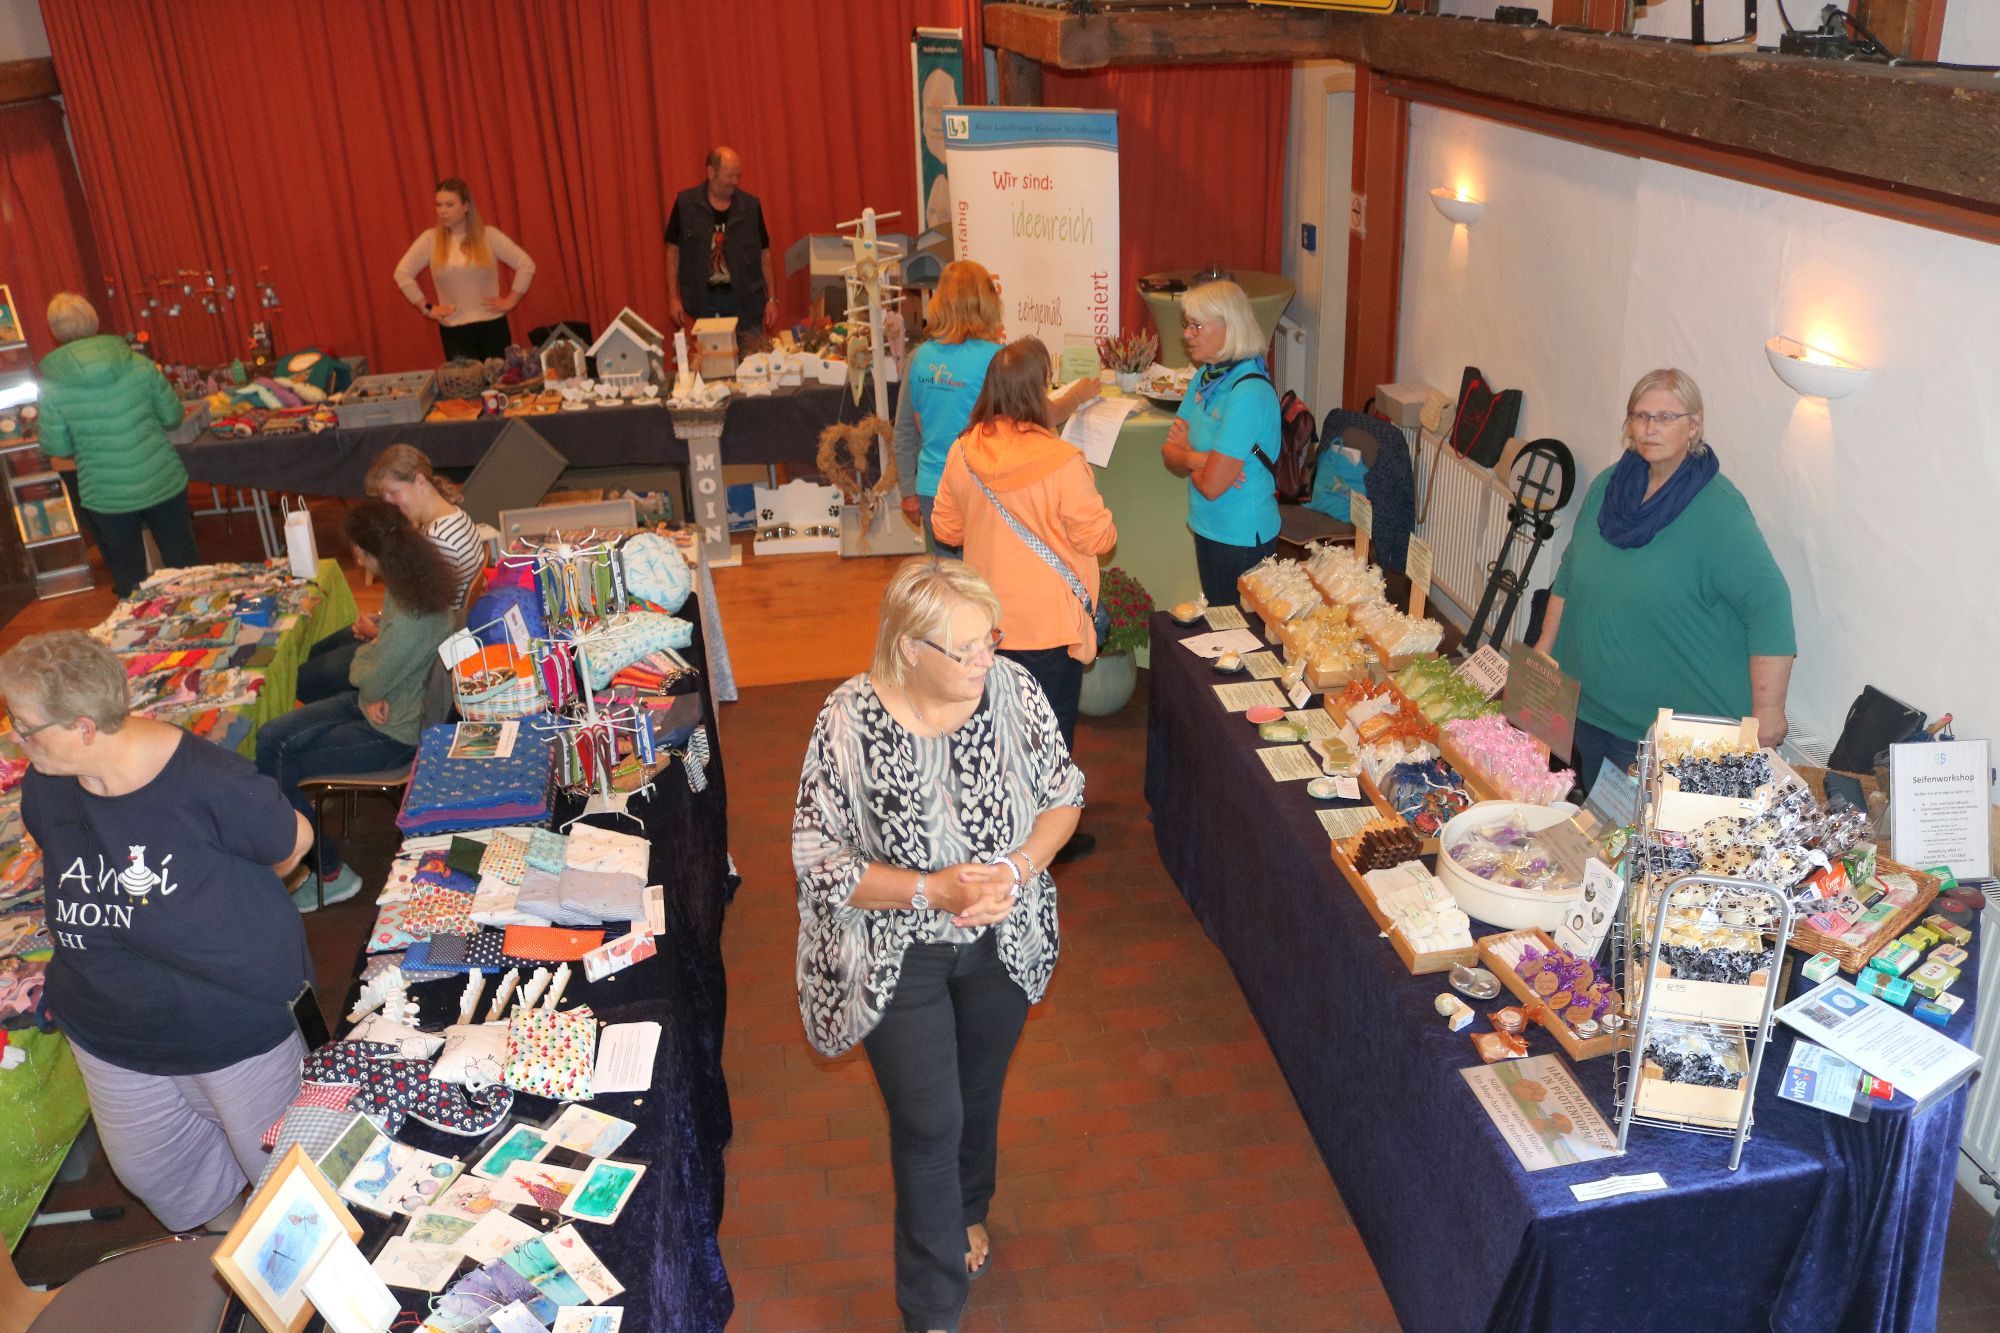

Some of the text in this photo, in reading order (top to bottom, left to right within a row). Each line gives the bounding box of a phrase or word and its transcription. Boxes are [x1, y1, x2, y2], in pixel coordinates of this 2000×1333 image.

[992, 171, 1053, 190] Wir sind:
[1011, 200, 1093, 245] ideenreich
[1018, 294, 1063, 335] zeitgemäß
[695, 454, 722, 543] MOIN
[1472, 655, 1504, 686] MARSEILLE
[1480, 648, 1498, 666] SEIFE
[1912, 774, 1975, 784] Seifenworkshop
[56, 899, 135, 929] MOIN
[57, 931, 87, 950] HI
[1925, 965, 1942, 979] LUX
[1546, 1066, 1601, 1128] HANDGEMACHTE
[1790, 1080, 1807, 1099] vhs
[1540, 1075, 1594, 1140] IN PFOTENFORM
